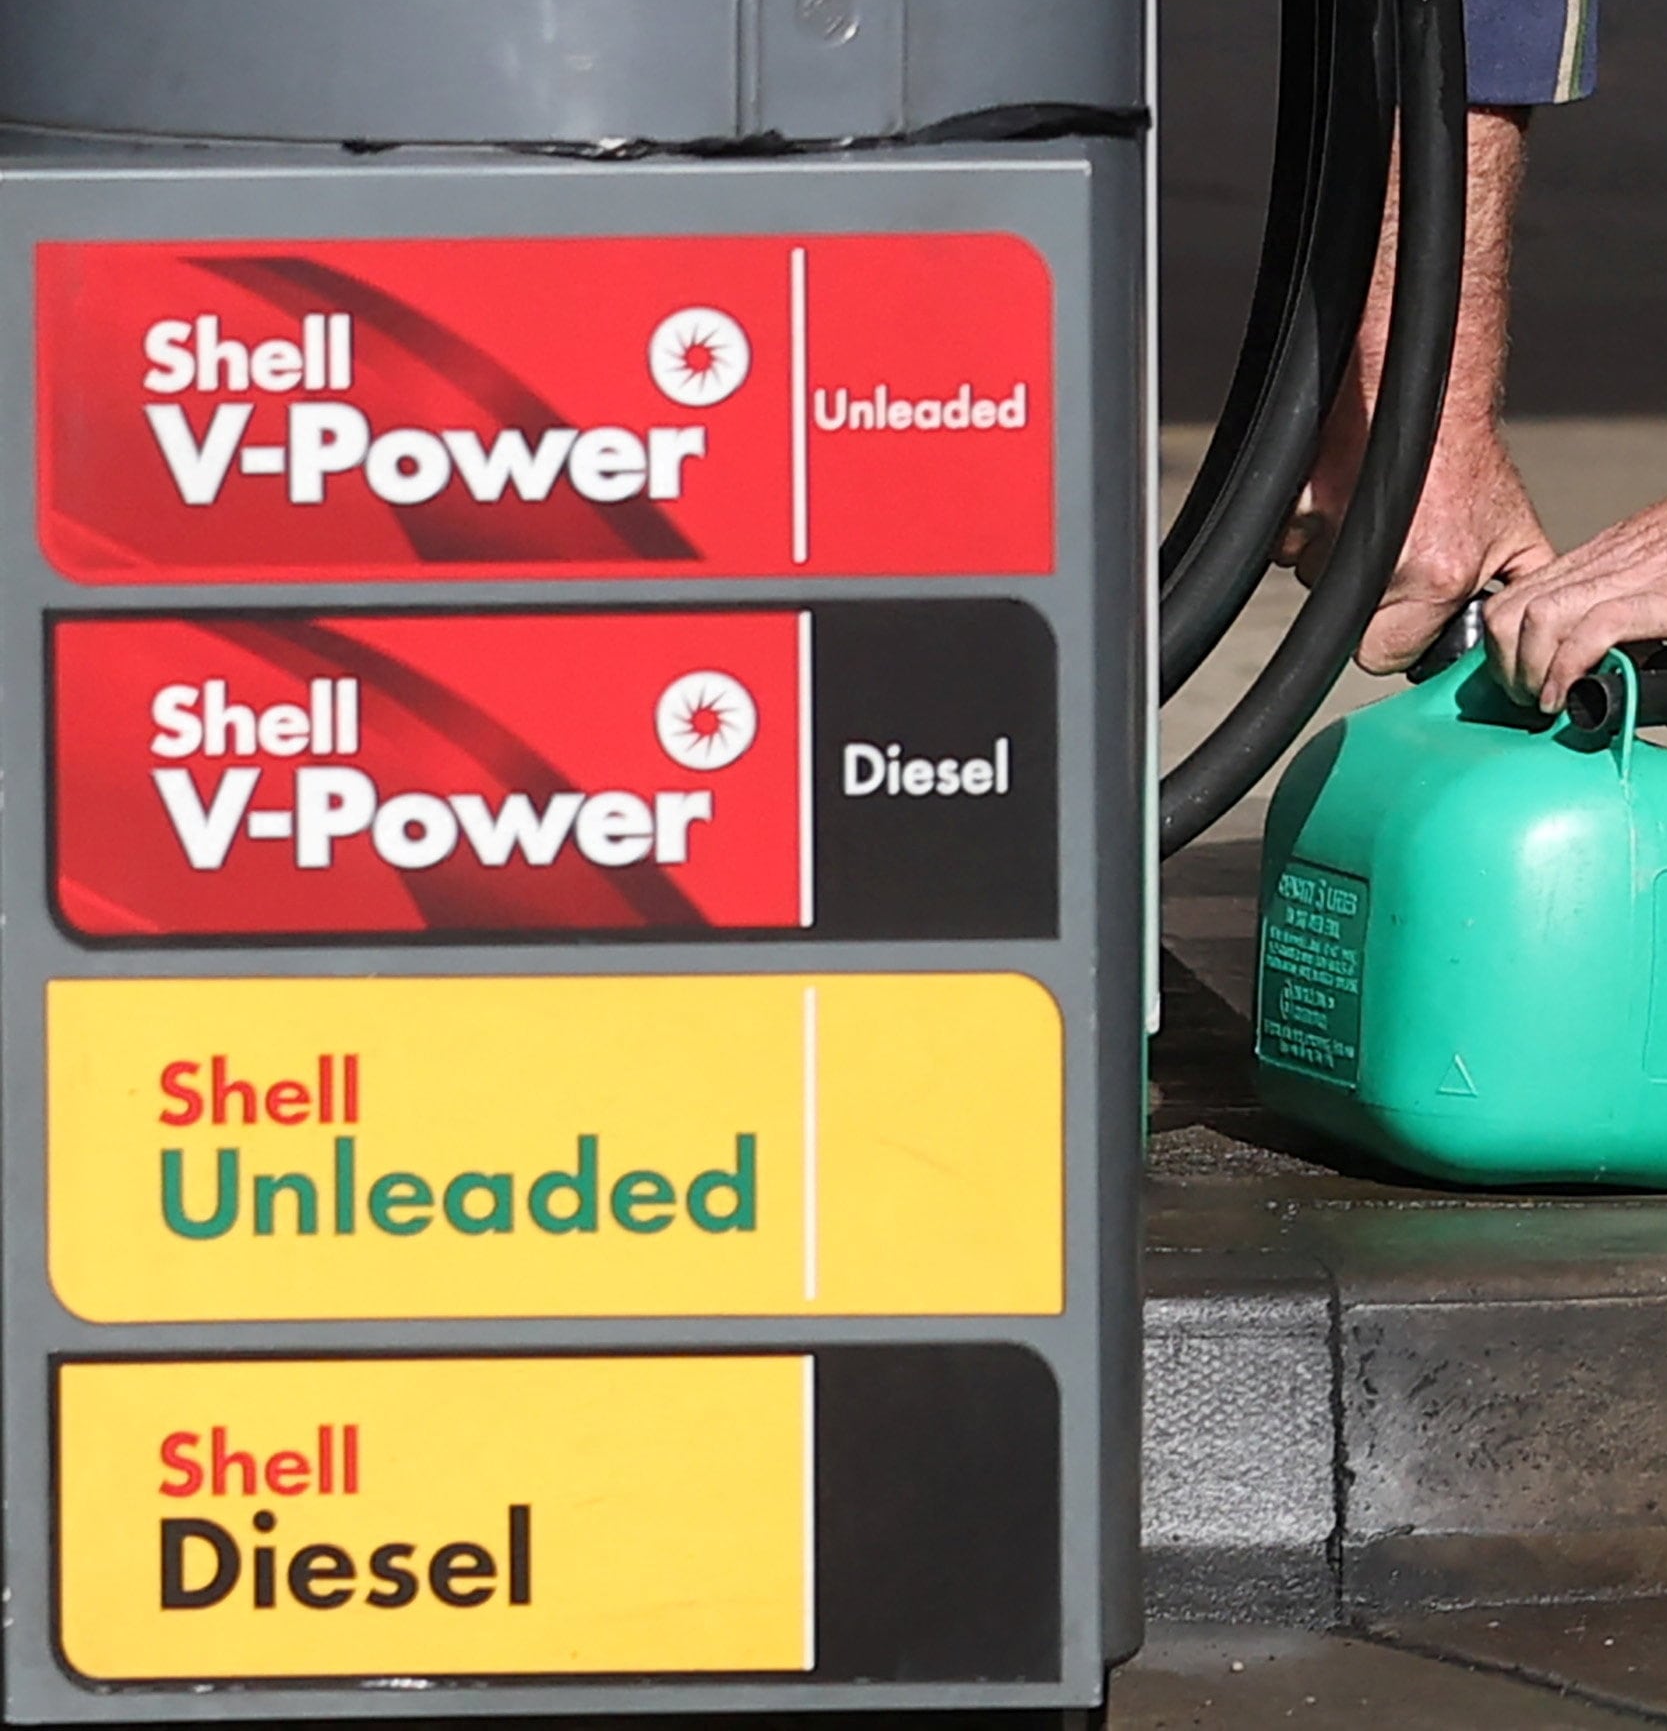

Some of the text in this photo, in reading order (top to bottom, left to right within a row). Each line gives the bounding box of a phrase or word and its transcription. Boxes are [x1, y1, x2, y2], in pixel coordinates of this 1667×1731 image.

[144, 313, 351, 393] Shell
[814, 383, 1027, 431] Unleaded
[144, 402, 707, 506] V-Power
[151, 678, 358, 758] Shell
[843, 736, 1010, 797] Diesel
[152, 766, 713, 870] V-Power
[159, 1054, 359, 1127] Shell
[160, 1133, 757, 1240] Unleaded
[159, 1424, 359, 1498] Shell
[159, 1505, 531, 1611] Diesel
